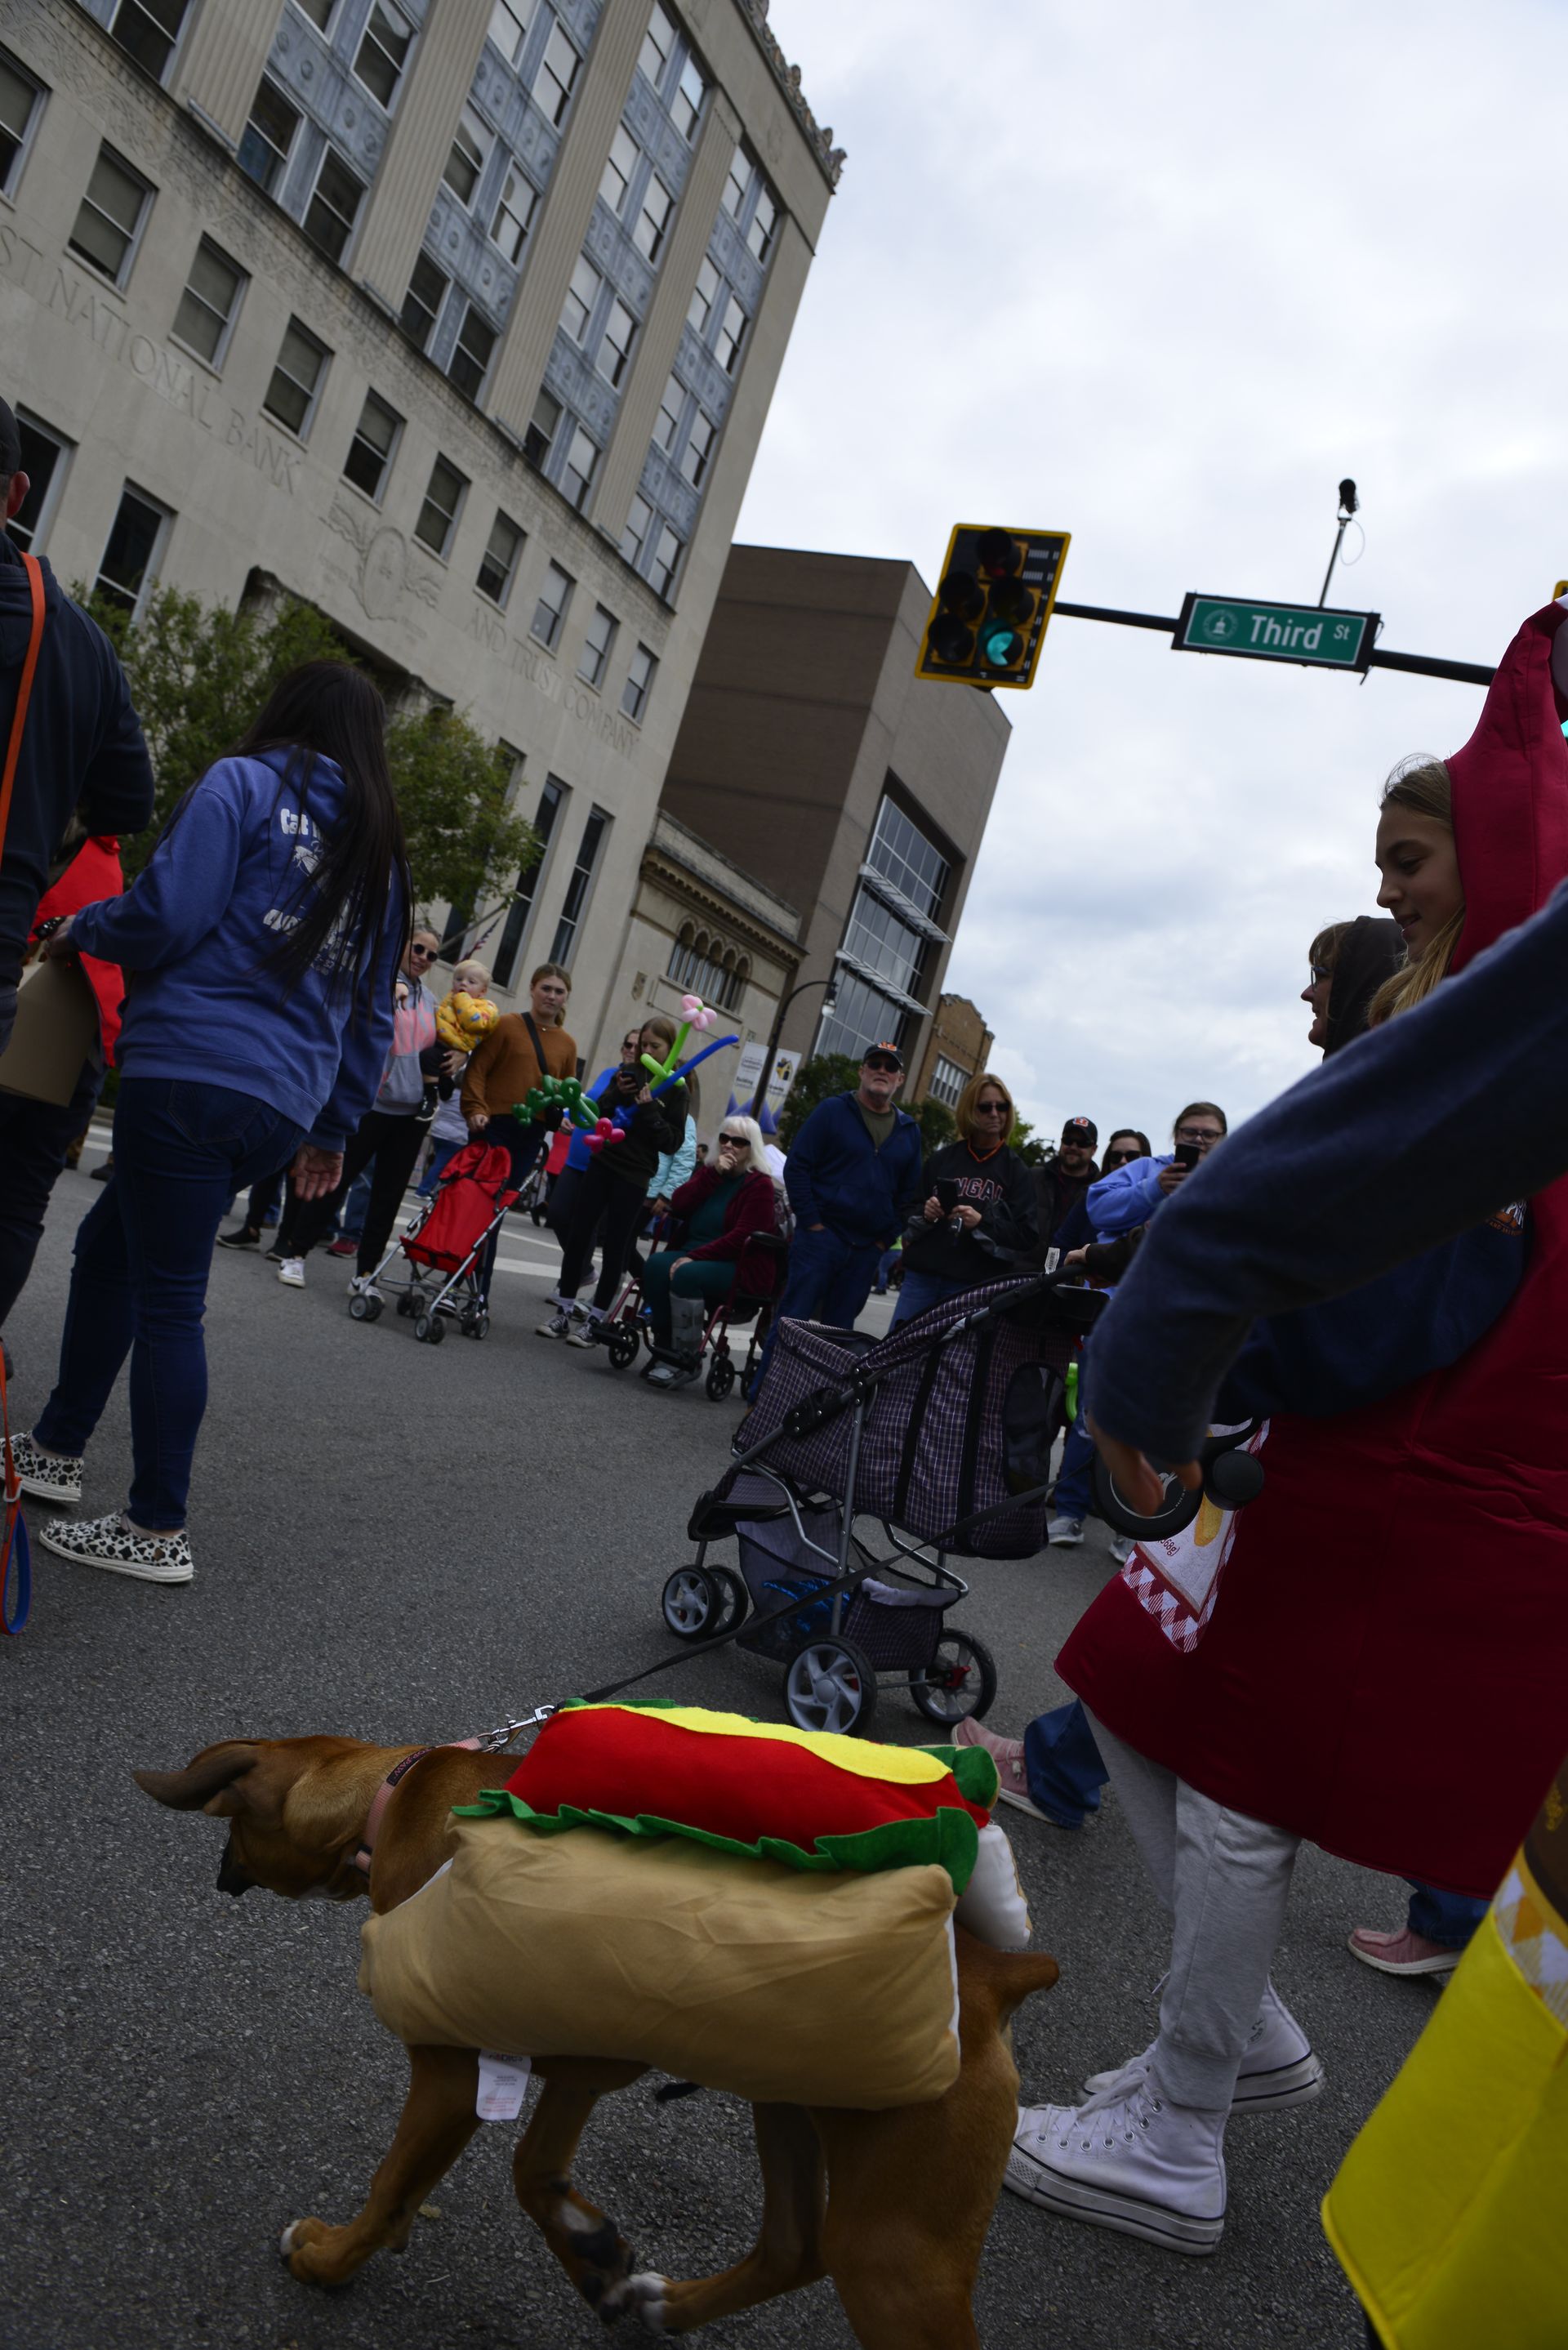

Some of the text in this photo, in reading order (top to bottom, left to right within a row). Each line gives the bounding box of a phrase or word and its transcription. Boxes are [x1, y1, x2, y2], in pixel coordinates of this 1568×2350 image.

[48, 267, 212, 430] NATIONAL
[225, 407, 301, 495] BANK
[464, 607, 639, 760] AND TRUST COMPANY
[1250, 614, 1324, 650] Third
[1333, 624, 1351, 640] St
